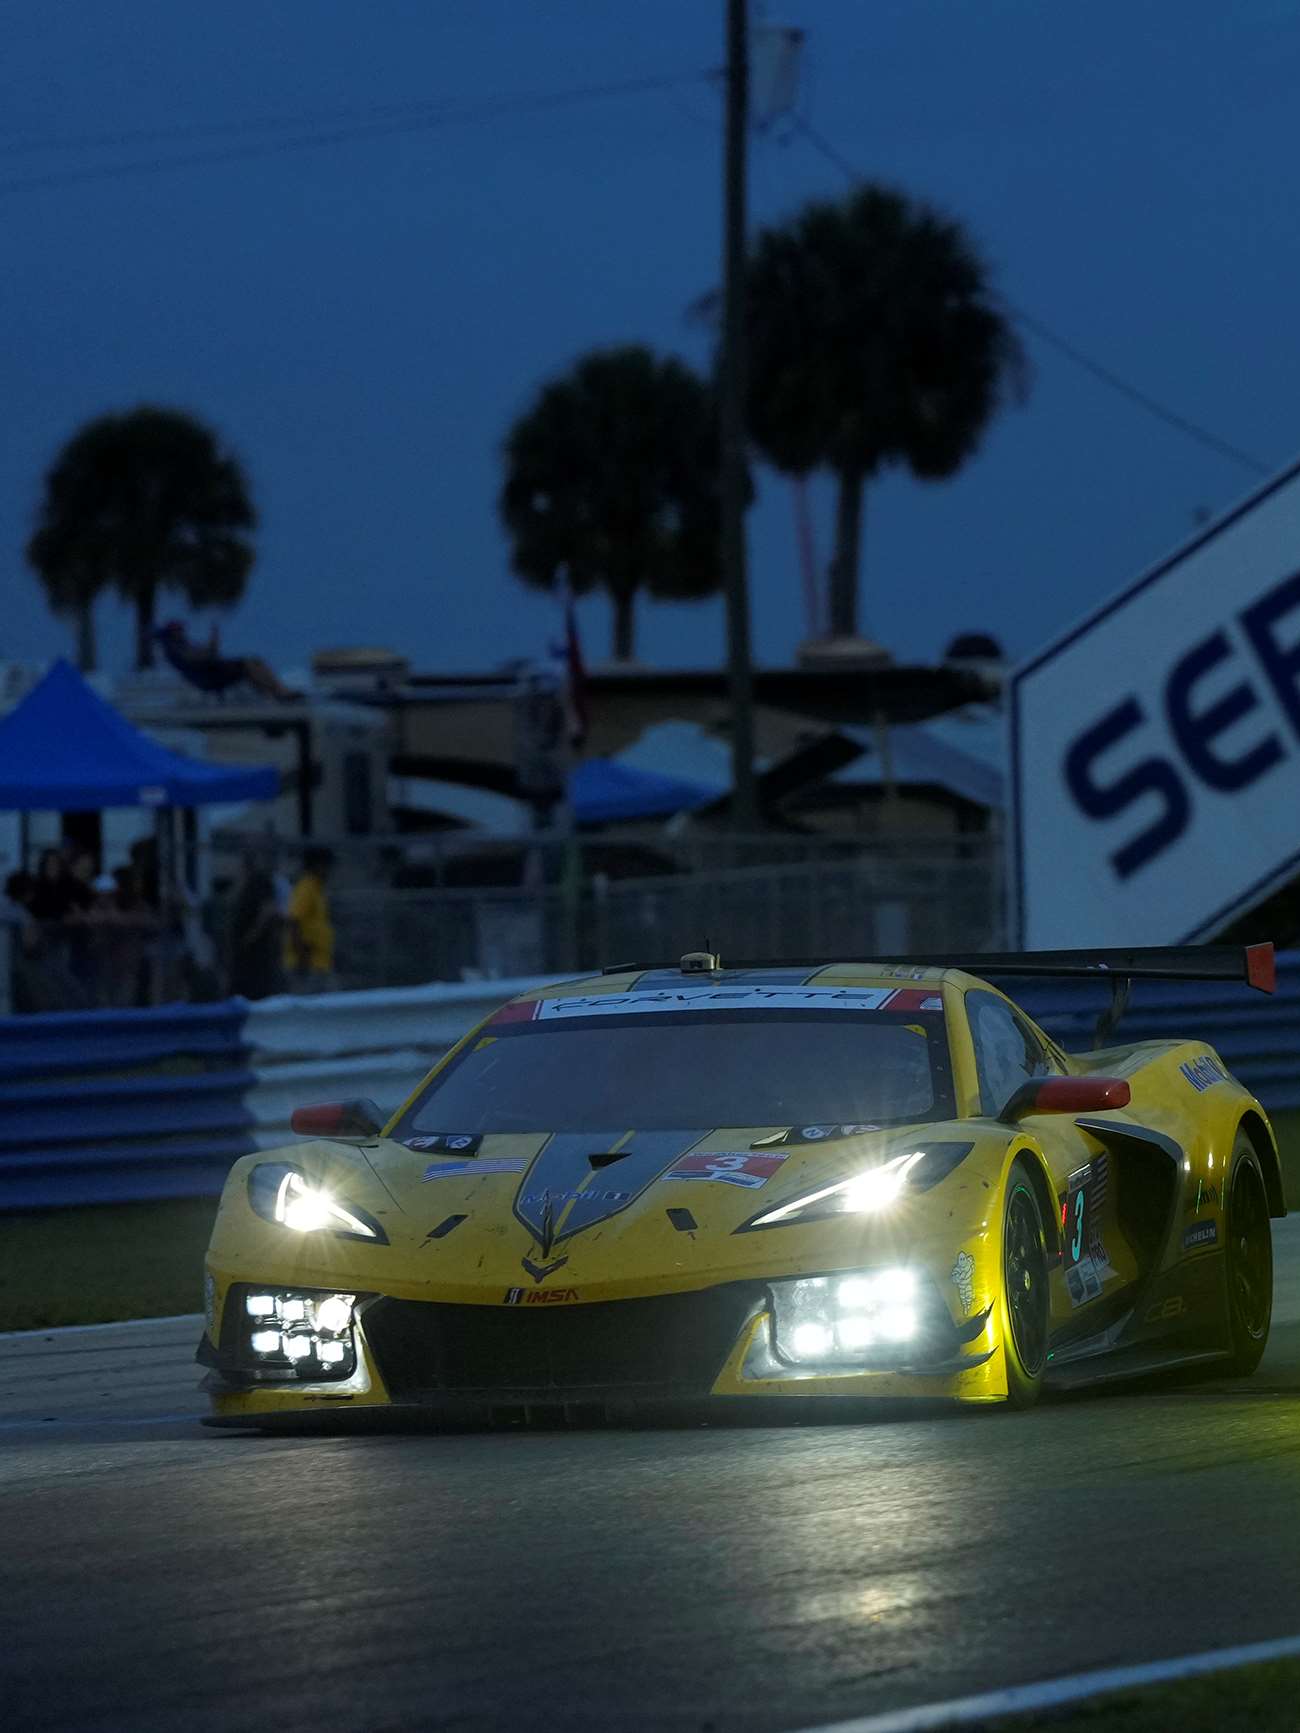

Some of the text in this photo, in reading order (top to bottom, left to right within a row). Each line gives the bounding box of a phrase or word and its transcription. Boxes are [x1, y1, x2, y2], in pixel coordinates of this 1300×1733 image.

[705, 1155, 750, 1171] 3
[1071, 1189, 1086, 1261] 3
[526, 1288, 579, 1303] IMSA
